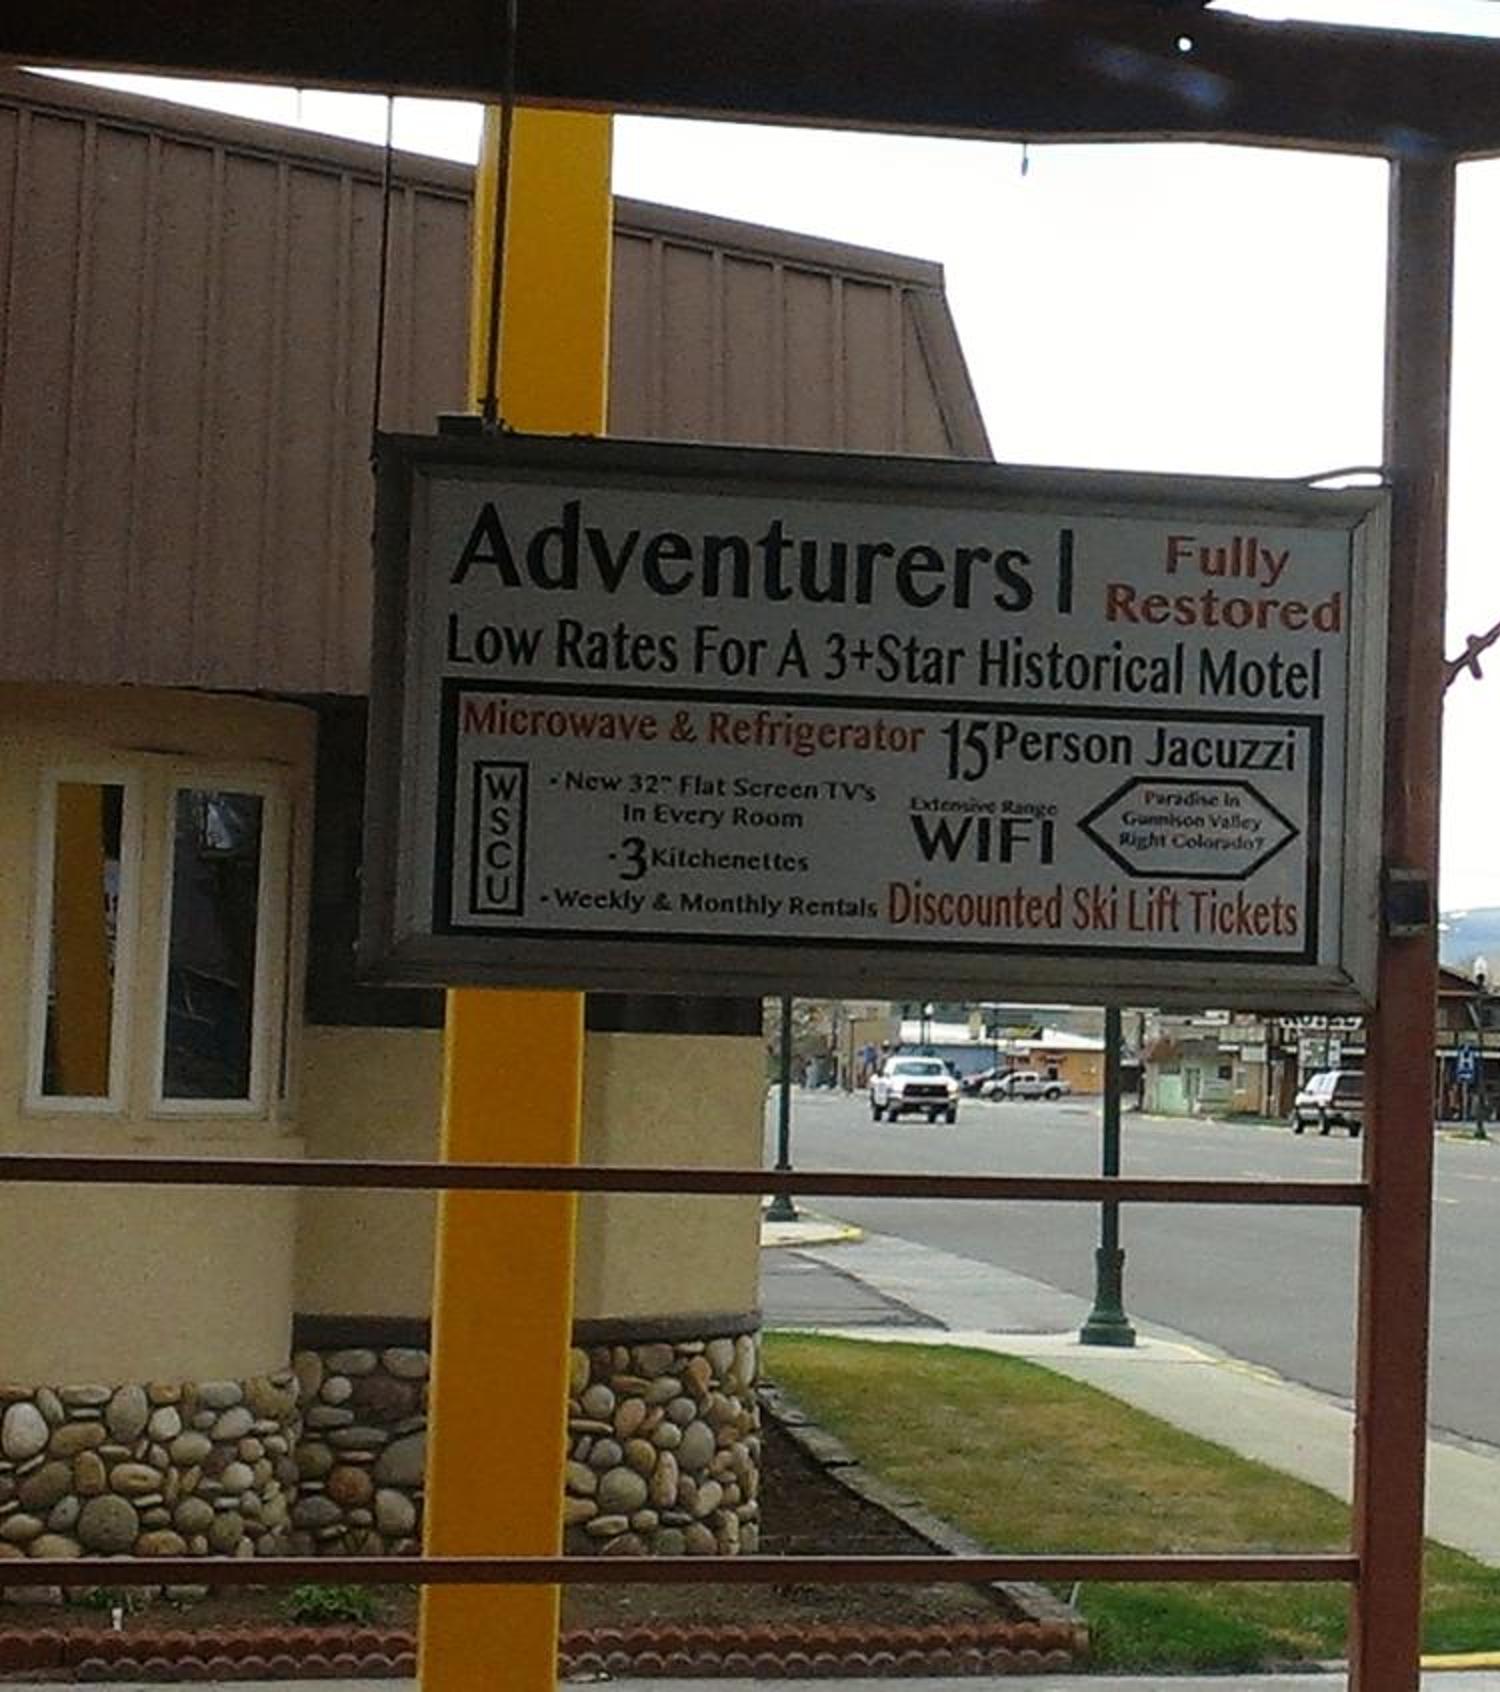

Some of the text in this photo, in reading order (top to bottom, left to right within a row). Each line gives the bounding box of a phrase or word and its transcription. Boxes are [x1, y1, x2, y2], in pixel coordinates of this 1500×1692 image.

[450, 501, 1033, 612] Adventurers
[1165, 535, 1290, 587] Fully
[1105, 583, 1342, 633] Restored
[447, 614, 543, 664] Low
[557, 619, 677, 672] Rates
[695, 625, 766, 676] For
[777, 629, 808, 678] A
[979, 637, 1183, 693] Historical
[1200, 648, 1321, 699] Motel
[462, 702, 925, 757] Microwave & Refrigerator
[994, 722, 1132, 766] Person
[1146, 727, 1295, 771] Jacuzzi
[565, 771, 622, 792] New
[679, 775, 724, 796] Flat
[733, 778, 817, 799] Screen
[823, 780, 876, 802] TV's
[910, 796, 1058, 818] Extensive Range
[1145, 791, 1218, 807] Paradise
[623, 804, 803, 829] In Every Room
[910, 815, 1054, 864] WIFI
[1119, 830, 1166, 849] Right
[1122, 811, 1262, 832] Gunnison Valley
[619, 837, 809, 881] 3 Kitchenettes
[554, 888, 878, 918] Weekly & Monthly Rentals
[889, 882, 1297, 937] Discounted Ski Lift Tickets
